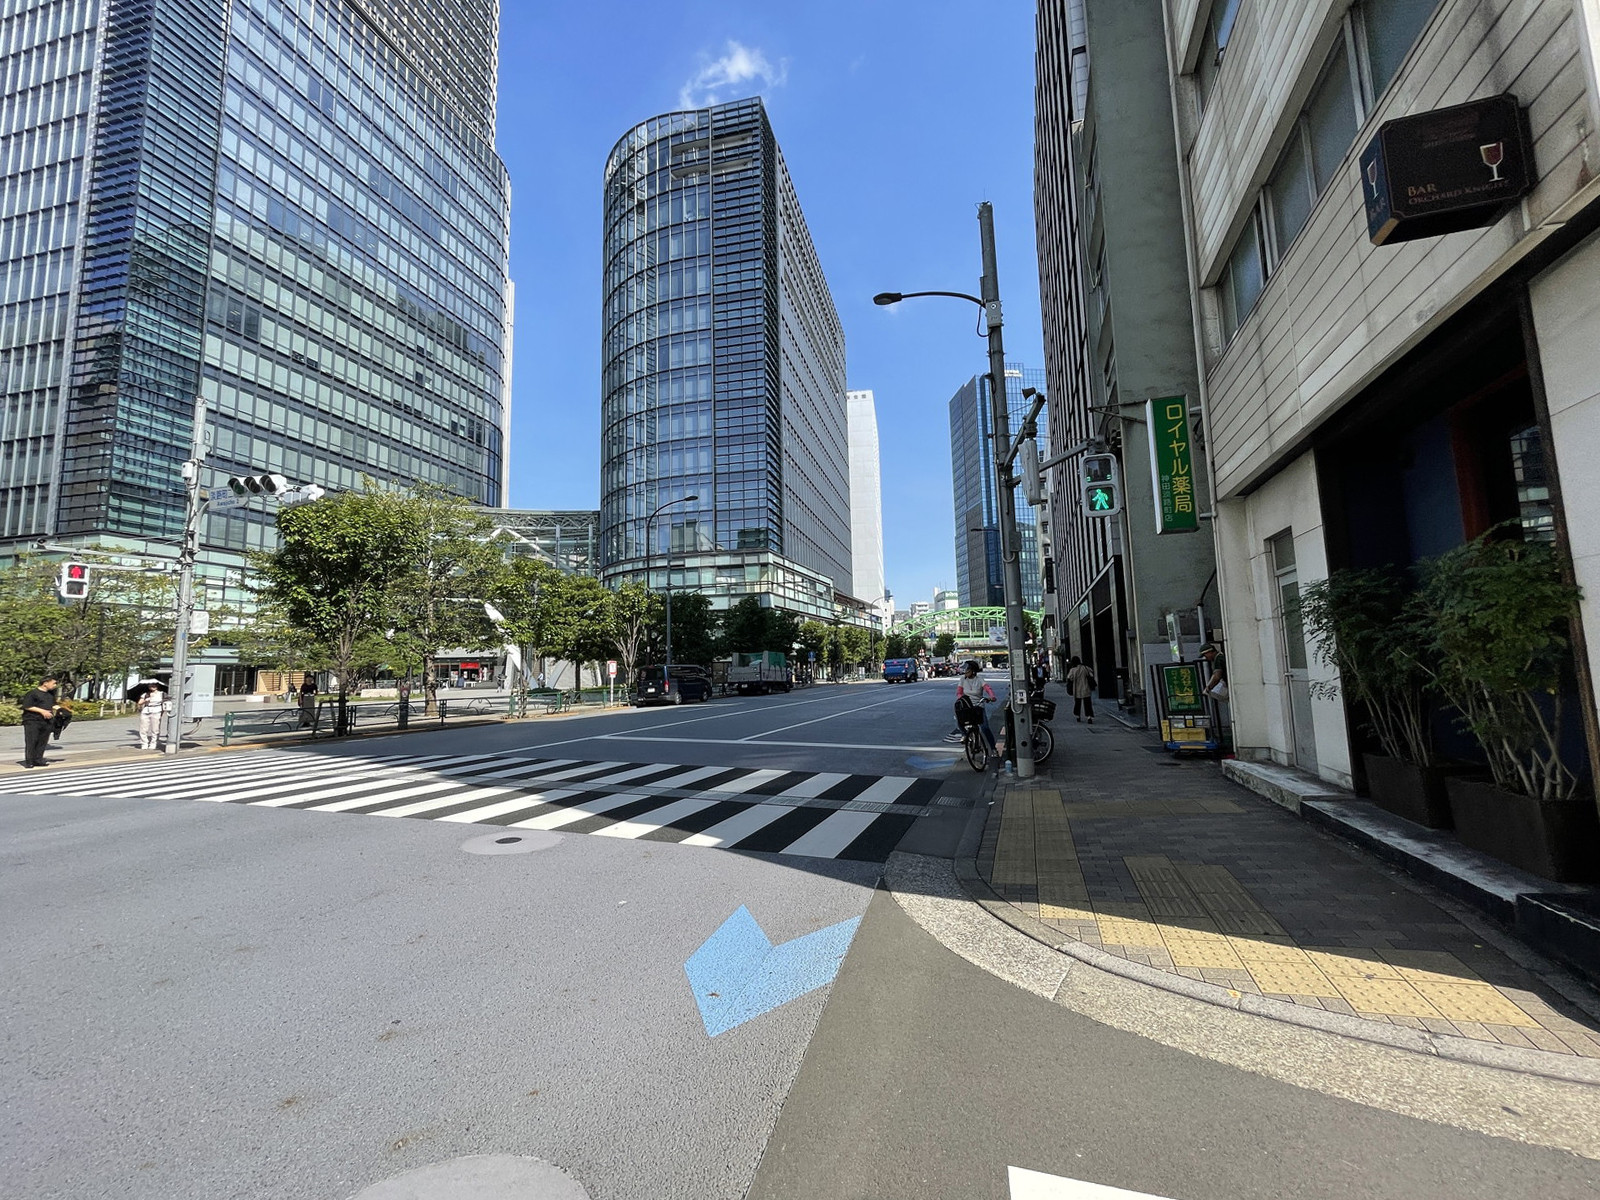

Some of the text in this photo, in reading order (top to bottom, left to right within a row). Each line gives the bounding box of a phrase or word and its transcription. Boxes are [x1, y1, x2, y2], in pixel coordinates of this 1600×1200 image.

[1407, 183, 1437, 197] BAR
[1408, 190, 1462, 205] ORCHARD
[1166, 404, 1192, 514] ロイヤル薬局
